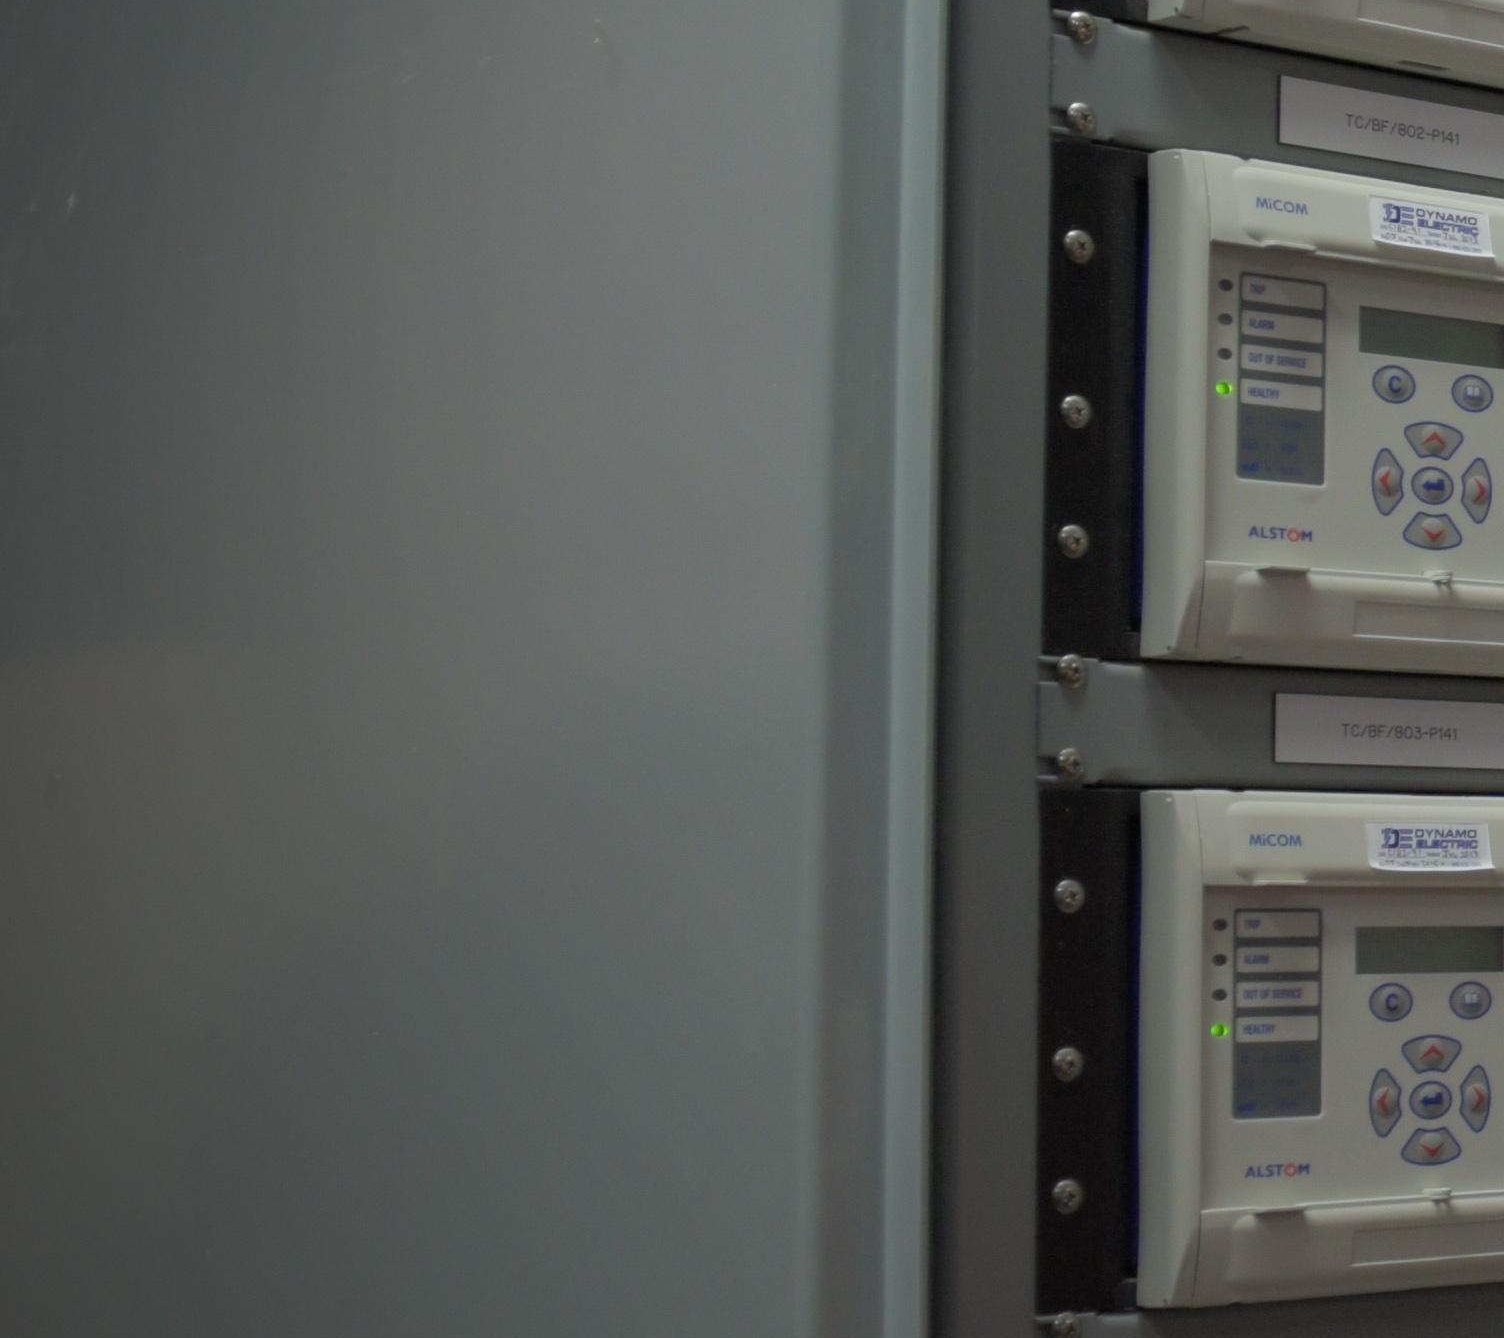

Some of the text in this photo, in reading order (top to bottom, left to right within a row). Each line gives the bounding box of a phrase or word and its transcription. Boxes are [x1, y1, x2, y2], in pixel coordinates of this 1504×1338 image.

[1343, 112, 1462, 148] TC/BF/802-P141
[1255, 195, 1309, 217] MiCOM
[1415, 207, 1479, 227] DYNAMO
[1416, 217, 1480, 238] ELECTRIC
[1248, 282, 1267, 296] TRIP
[1248, 318, 1276, 332] ALARM
[1248, 351, 1308, 370] OUT OF SERVICE
[1386, 373, 1403, 394] C
[1247, 386, 1281, 400] HEALTHY
[1246, 523, 1314, 545] ALSTOM
[1339, 720, 1460, 744] TC/BF/803-P141
[1247, 831, 1304, 849] MiCOM
[1414, 828, 1478, 839] DYNAMO
[1415, 838, 1479, 850] ELECTRIC
[1243, 918, 1261, 930] TRIP
[1242, 953, 1270, 965] ALARM
[1242, 987, 1304, 1000] OUT OF SERVICE
[1382, 991, 1400, 1014] C
[1242, 1023, 1276, 1036] HEALTHY
[1243, 1162, 1311, 1180] ALSTOM
